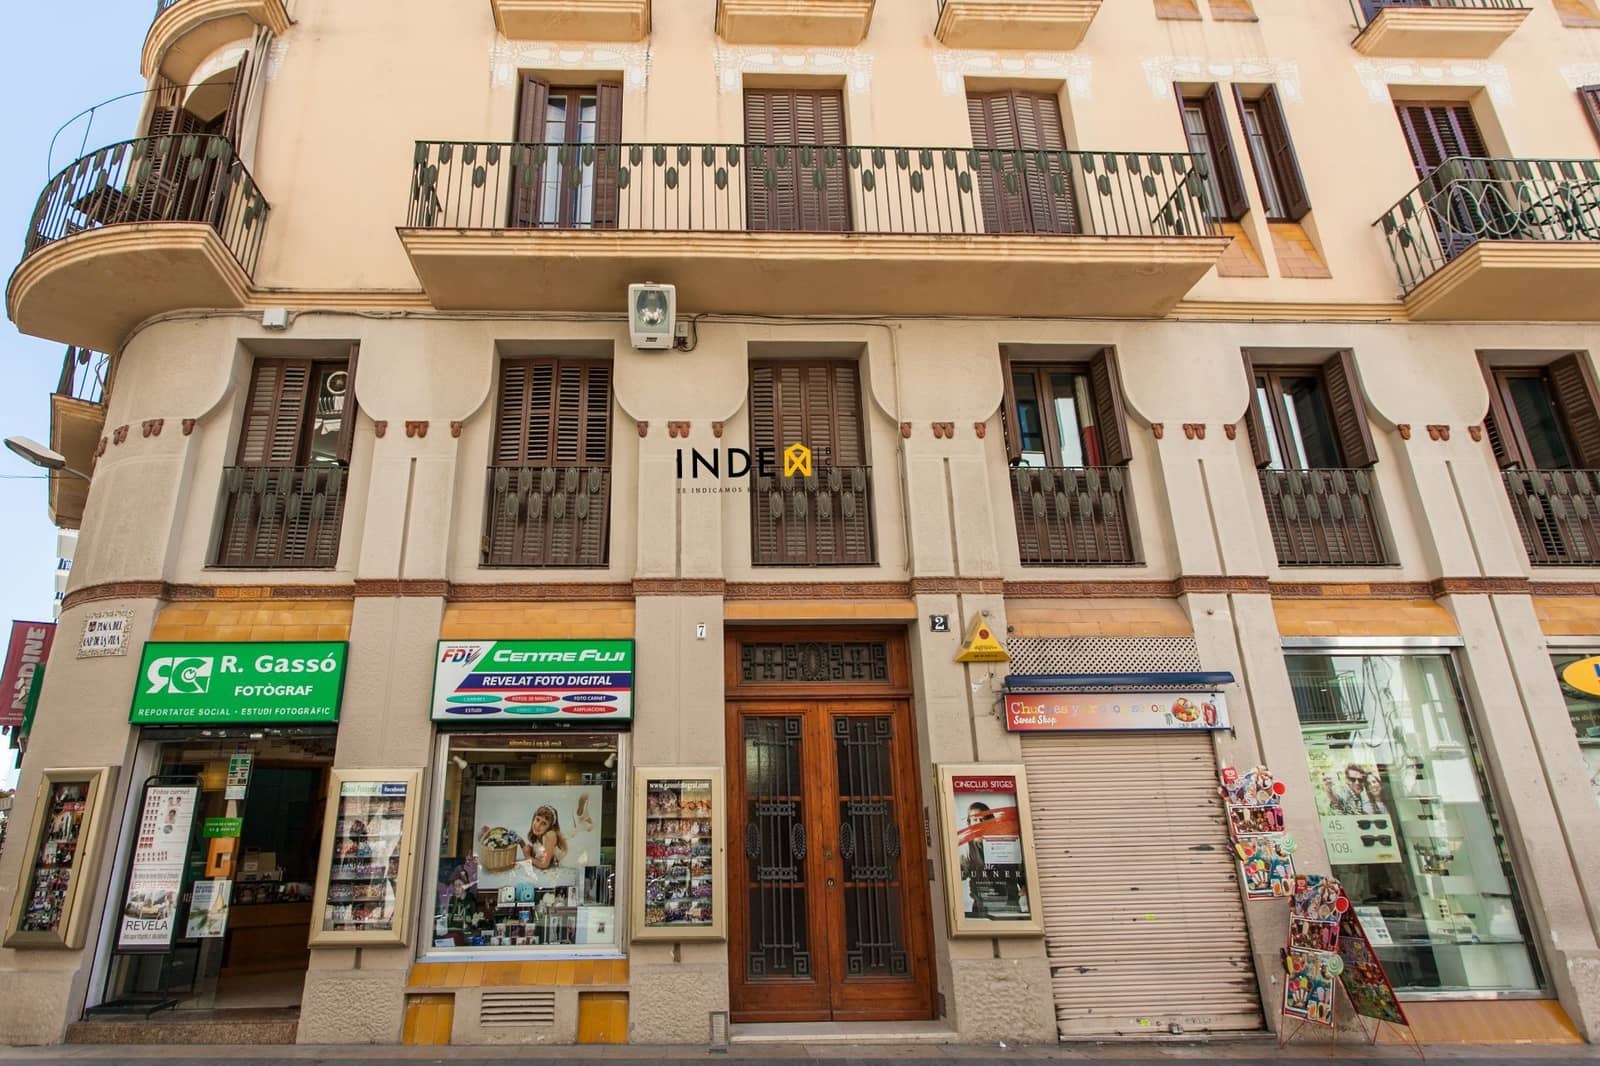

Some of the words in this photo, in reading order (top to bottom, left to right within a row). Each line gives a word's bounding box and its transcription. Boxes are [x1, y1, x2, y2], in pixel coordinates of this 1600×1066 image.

[934, 616, 945, 630] 2
[698, 625, 705, 638] 7
[220, 655, 244, 673] R.
[255, 652, 337, 674] Gassó
[482, 675, 533, 686] REVELAT
[534, 675, 565, 686] FOTO
[567, 674, 612, 686] DIGITAL
[234, 683, 313, 697] FOTÒGRAF
[138, 708, 197, 717] REPORTATGE
[198, 707, 231, 717] SOCIAL
[241, 707, 272, 716] ESTUDI
[274, 706, 330, 716] FOTOGRÀFIC
[1013, 715, 1036, 725] Sweet
[1037, 714, 1056, 726] Shop
[990, 780, 1014, 789] SITGES
[125, 920, 168, 931] REVELA
